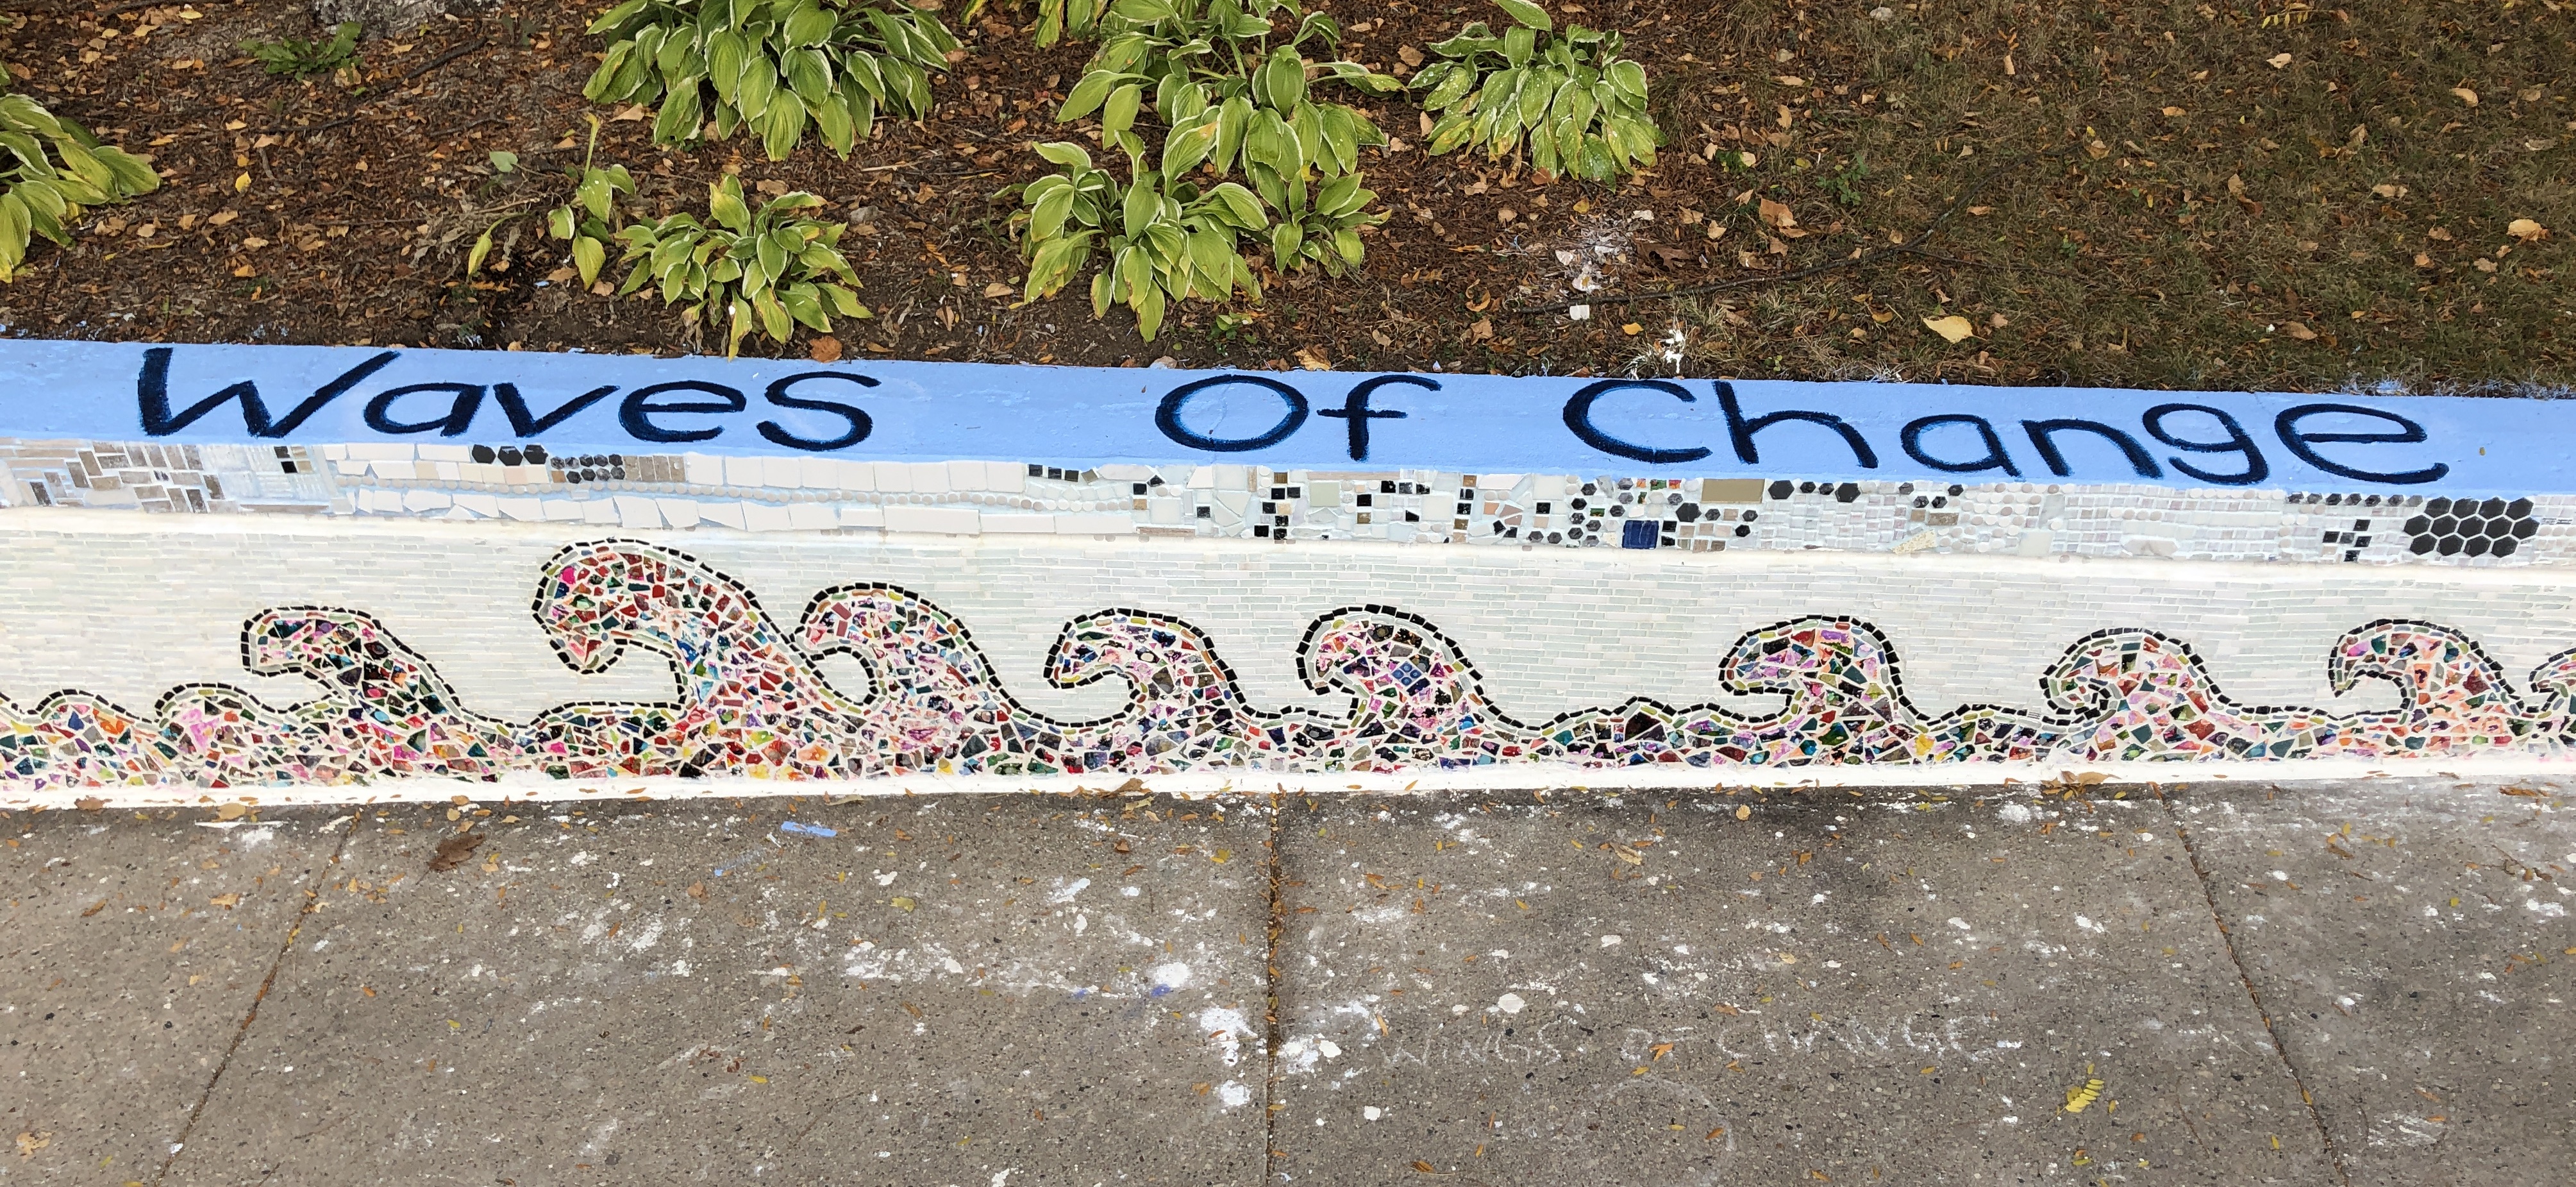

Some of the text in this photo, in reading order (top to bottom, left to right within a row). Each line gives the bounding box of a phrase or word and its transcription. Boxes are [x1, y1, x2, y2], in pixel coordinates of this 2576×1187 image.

[137, 346, 2451, 485] Waves Of Change
